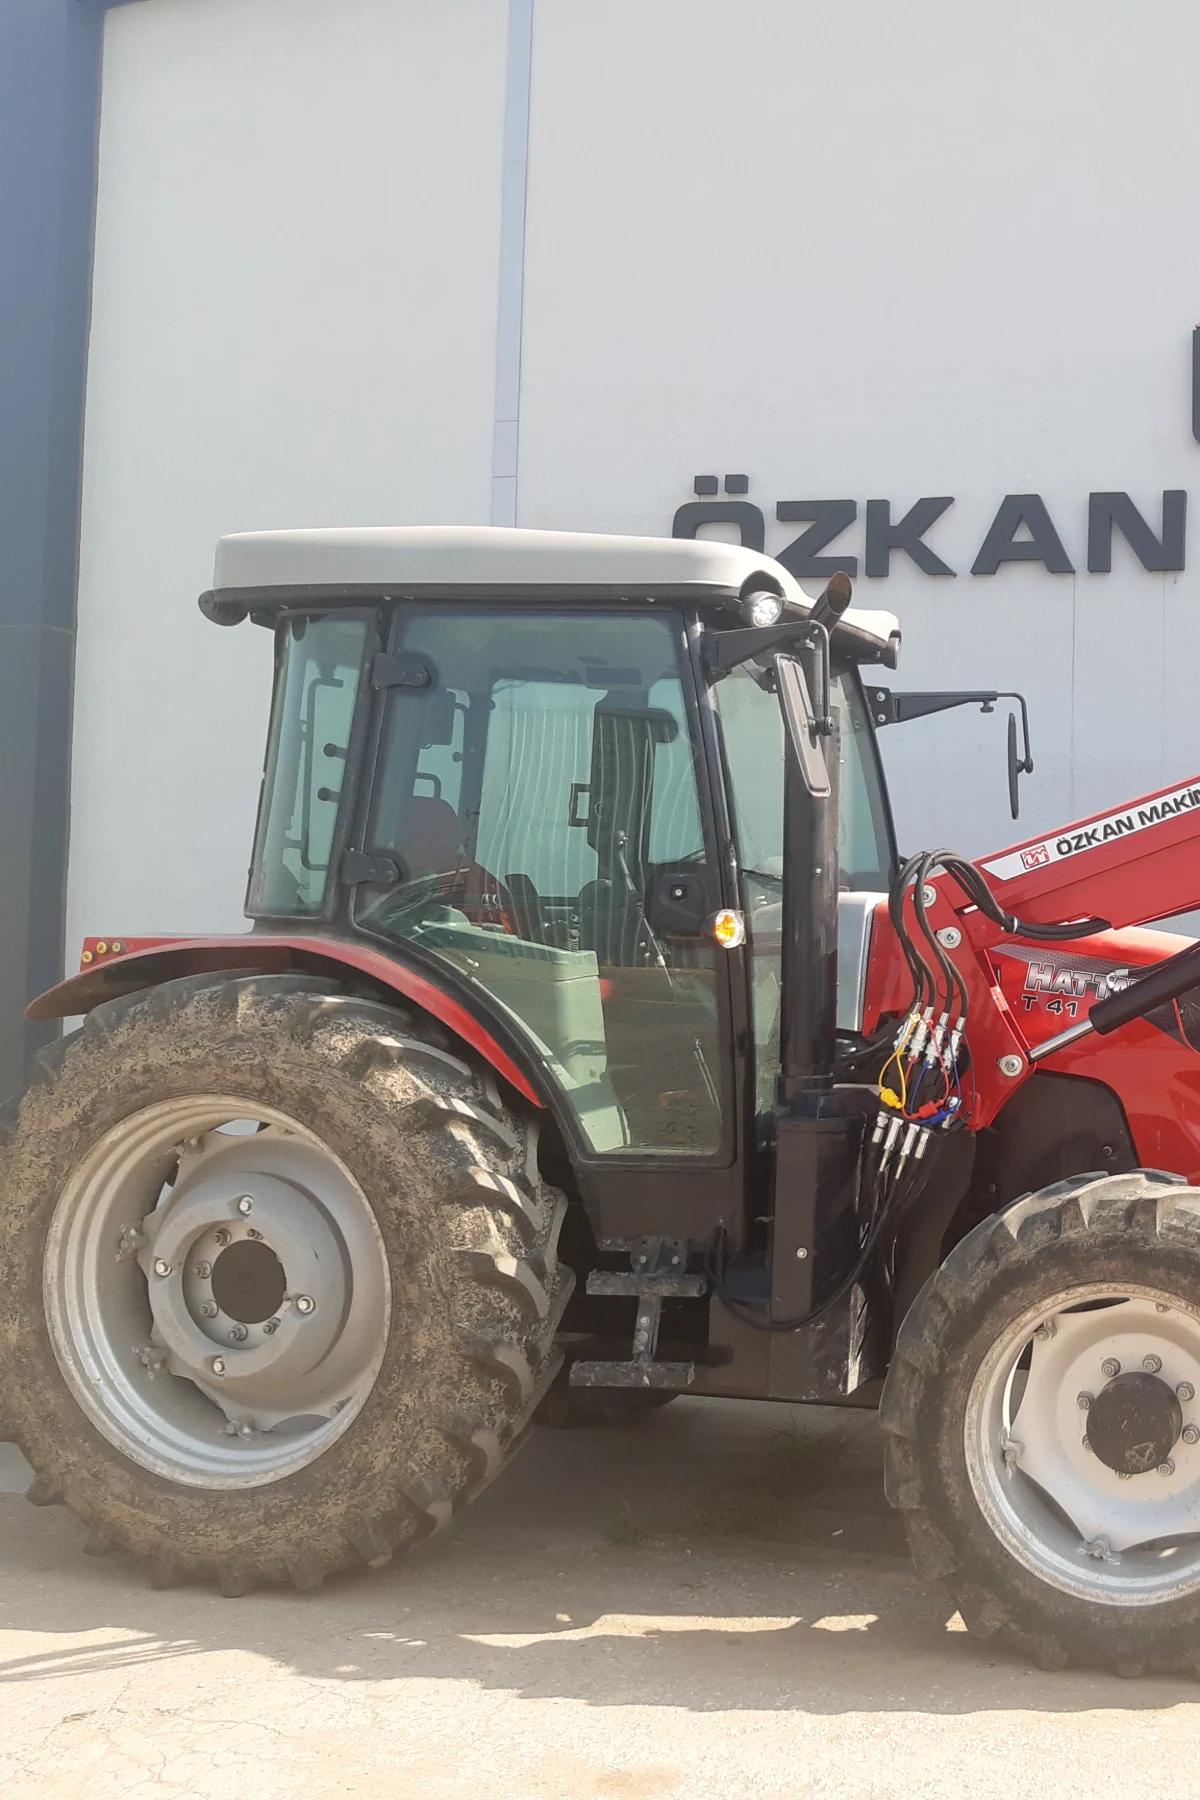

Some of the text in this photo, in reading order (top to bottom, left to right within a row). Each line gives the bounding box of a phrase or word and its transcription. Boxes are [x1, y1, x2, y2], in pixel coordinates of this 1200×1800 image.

[672, 474, 1187, 579] ÖZKAN
[1056, 816, 1134, 856] ÖZKAN
[1022, 995, 1037, 1011] T
